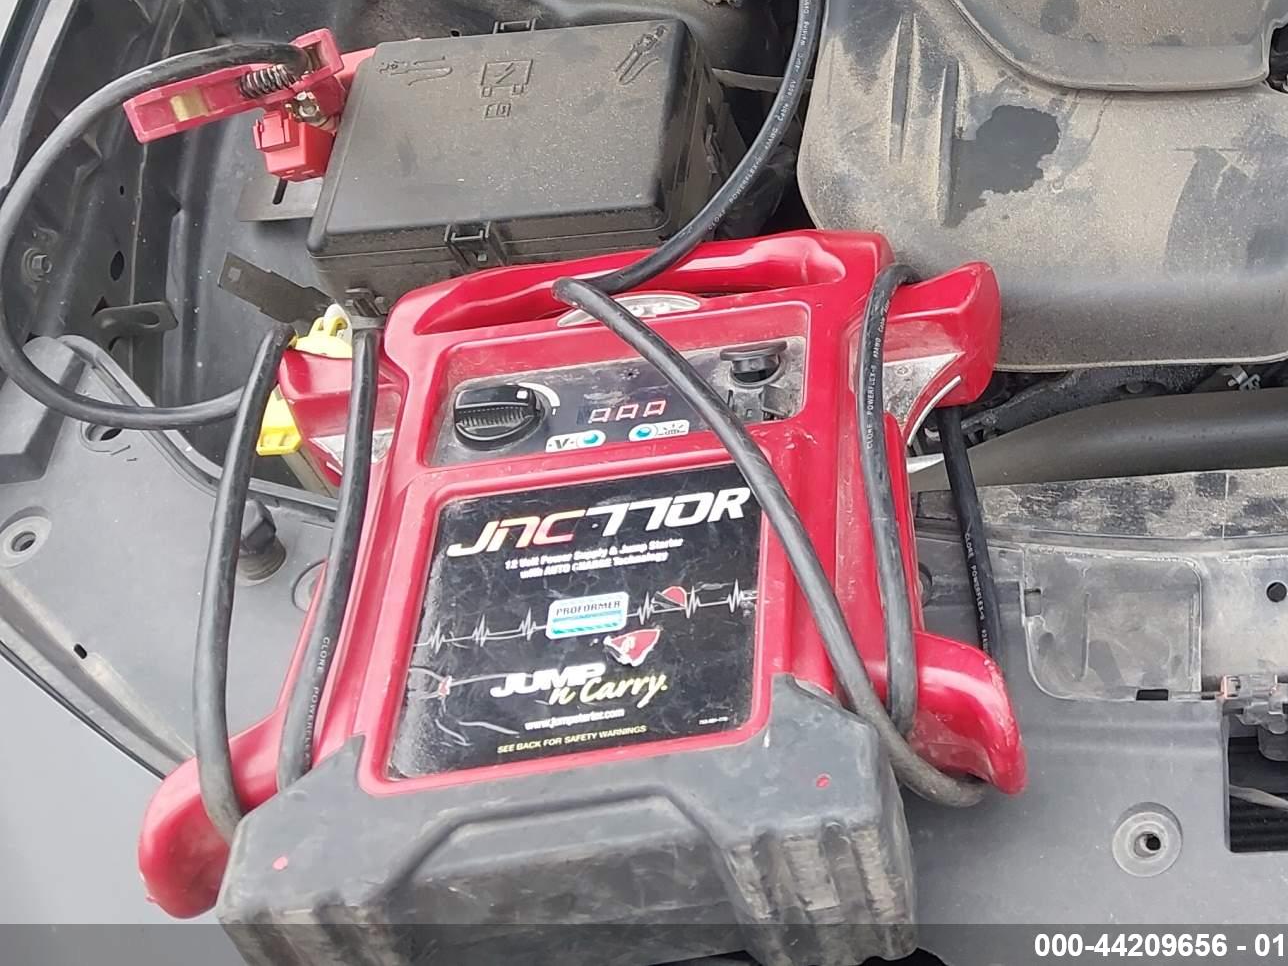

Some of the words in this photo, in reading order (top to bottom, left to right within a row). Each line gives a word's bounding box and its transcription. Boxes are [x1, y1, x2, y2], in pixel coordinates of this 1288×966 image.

[489, 662, 606, 699] JUMP
[497, 743, 515, 754] SEE
[516, 739, 542, 752] BACK
[543, 736, 563, 748] FOR
[564, 731, 597, 745] SAFETY
[599, 724, 648, 740] WARNINGS
